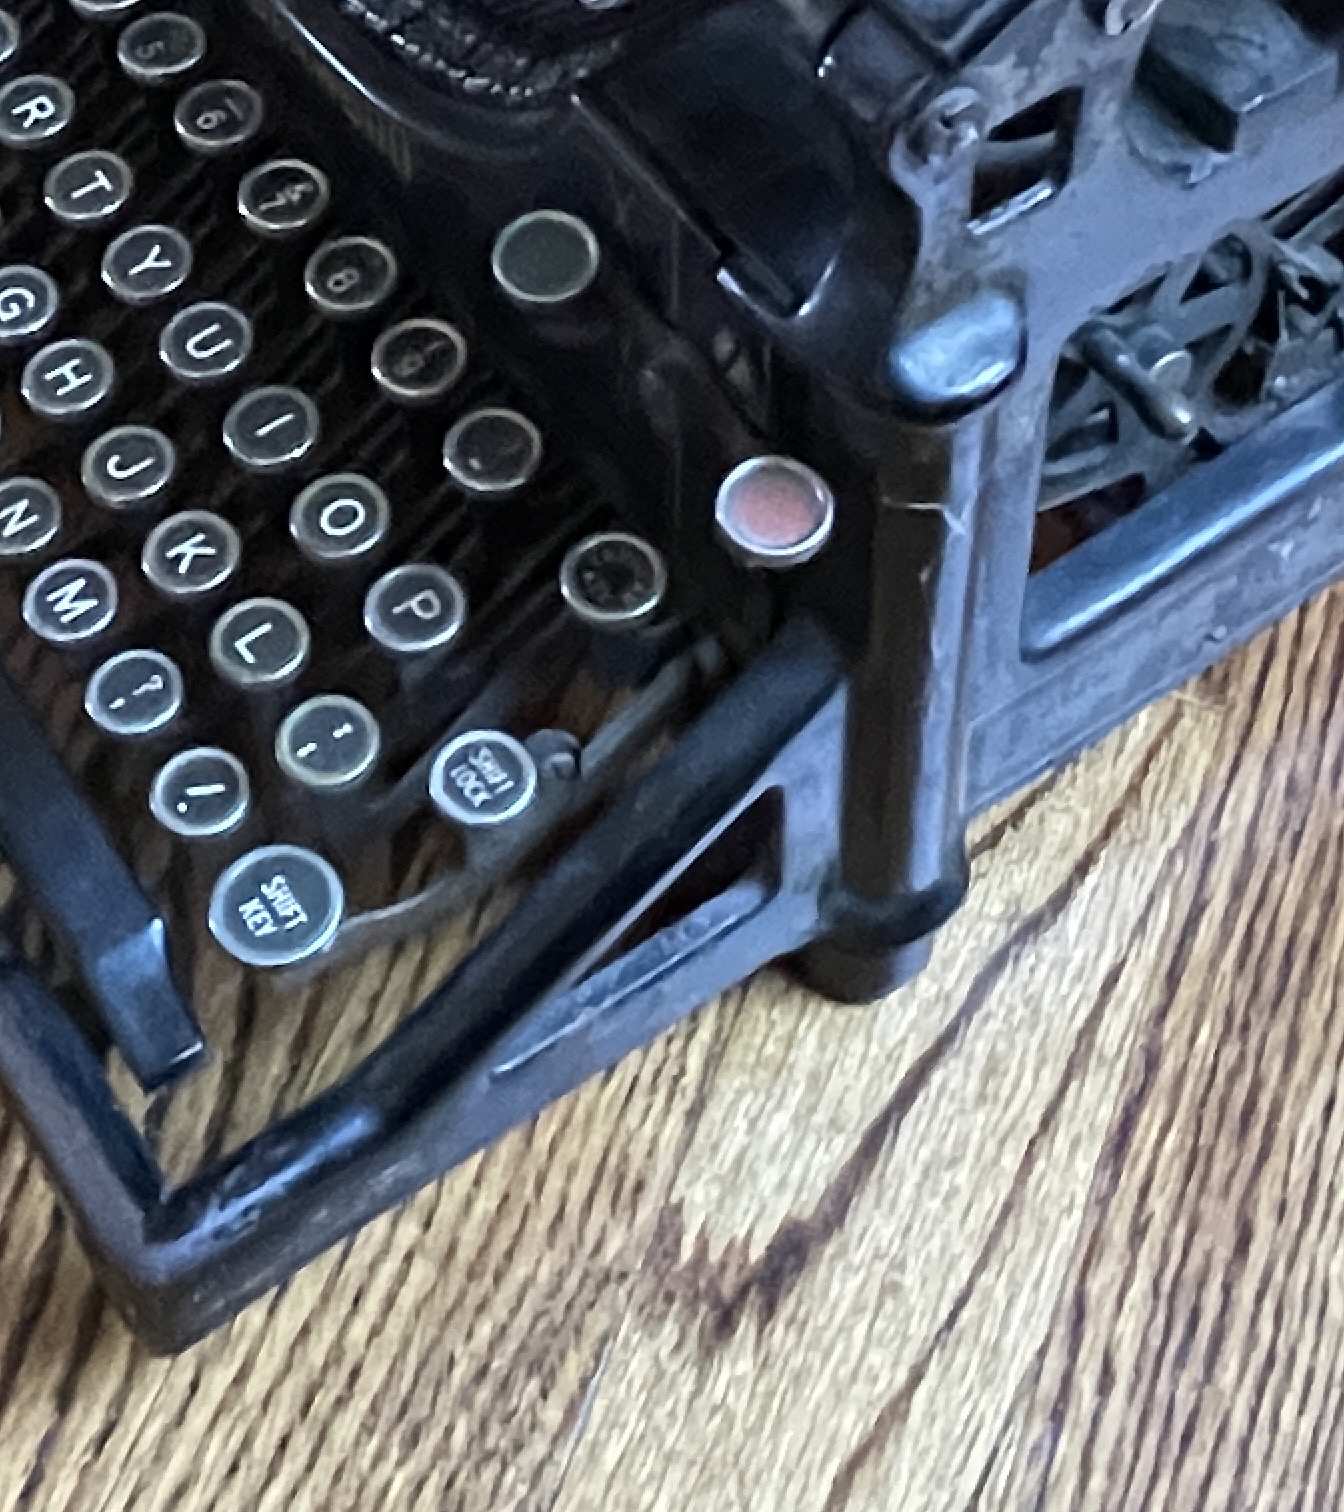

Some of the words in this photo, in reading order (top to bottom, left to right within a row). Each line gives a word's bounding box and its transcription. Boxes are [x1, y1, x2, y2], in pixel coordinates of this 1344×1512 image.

[11, 95, 55, 128] R
[70, 170, 113, 199] T
[128, 244, 173, 276] Y
[185, 324, 232, 359] U
[44, 358, 92, 396] H
[107, 454, 152, 479] J
[320, 498, 366, 536] O
[166, 534, 216, 574] K
[46, 577, 99, 624] M
[392, 590, 442, 620] P
[234, 622, 272, 664] L
[238, 897, 278, 938] KEY
[261, 876, 308, 930] SHIFT
